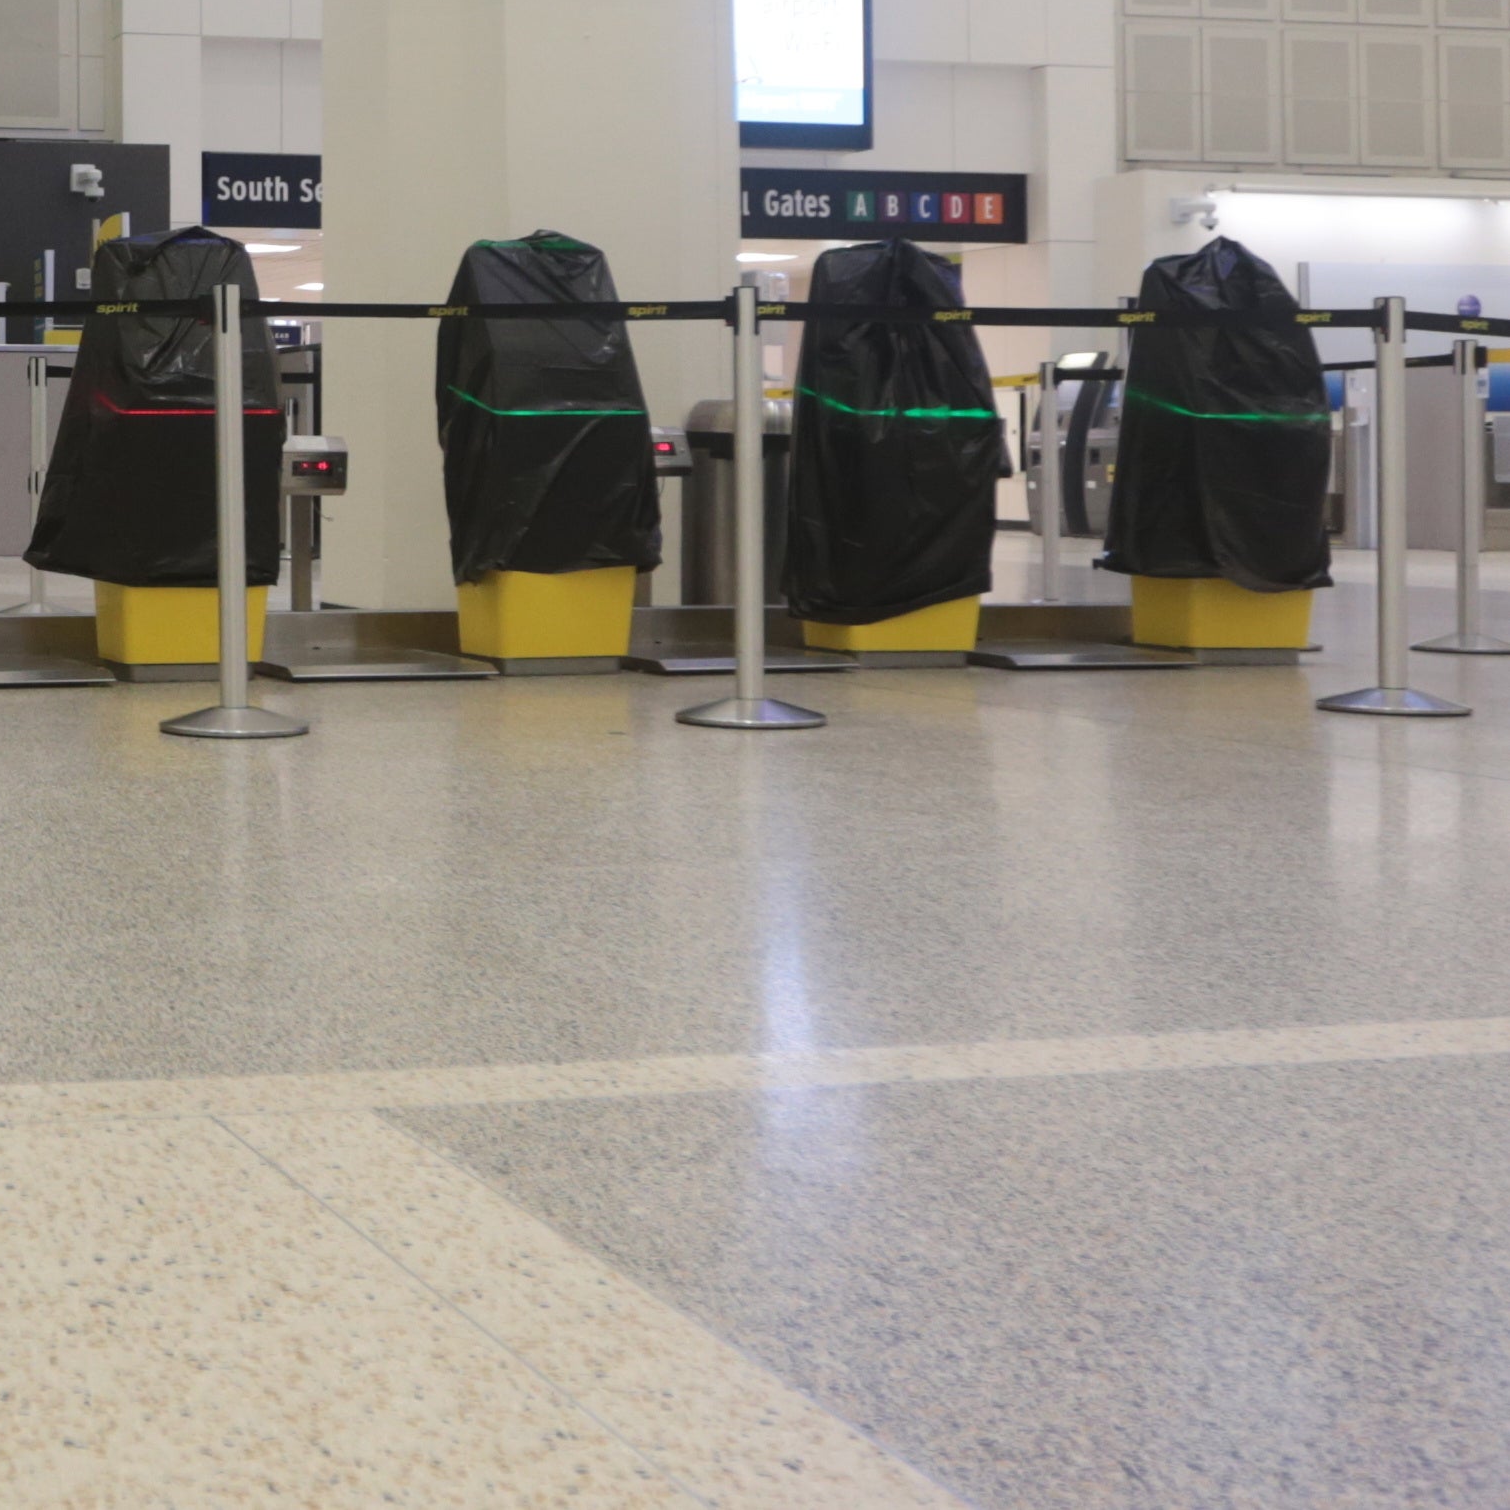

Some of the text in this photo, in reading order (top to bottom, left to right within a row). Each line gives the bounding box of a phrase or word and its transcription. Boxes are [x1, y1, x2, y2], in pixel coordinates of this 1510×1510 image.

[217, 176, 289, 202] South
[764, 189, 831, 219] Gates
[854, 193, 868, 217] A
[887, 194, 899, 217] B
[918, 195, 930, 219] C
[950, 195, 964, 219] D
[983, 196, 994, 219] E
[95, 302, 140, 315] spirit
[428, 305, 469, 316] spirit
[627, 305, 668, 318] spirit
[756, 304, 787, 315] pirit
[1117, 311, 1157, 324] spirit
